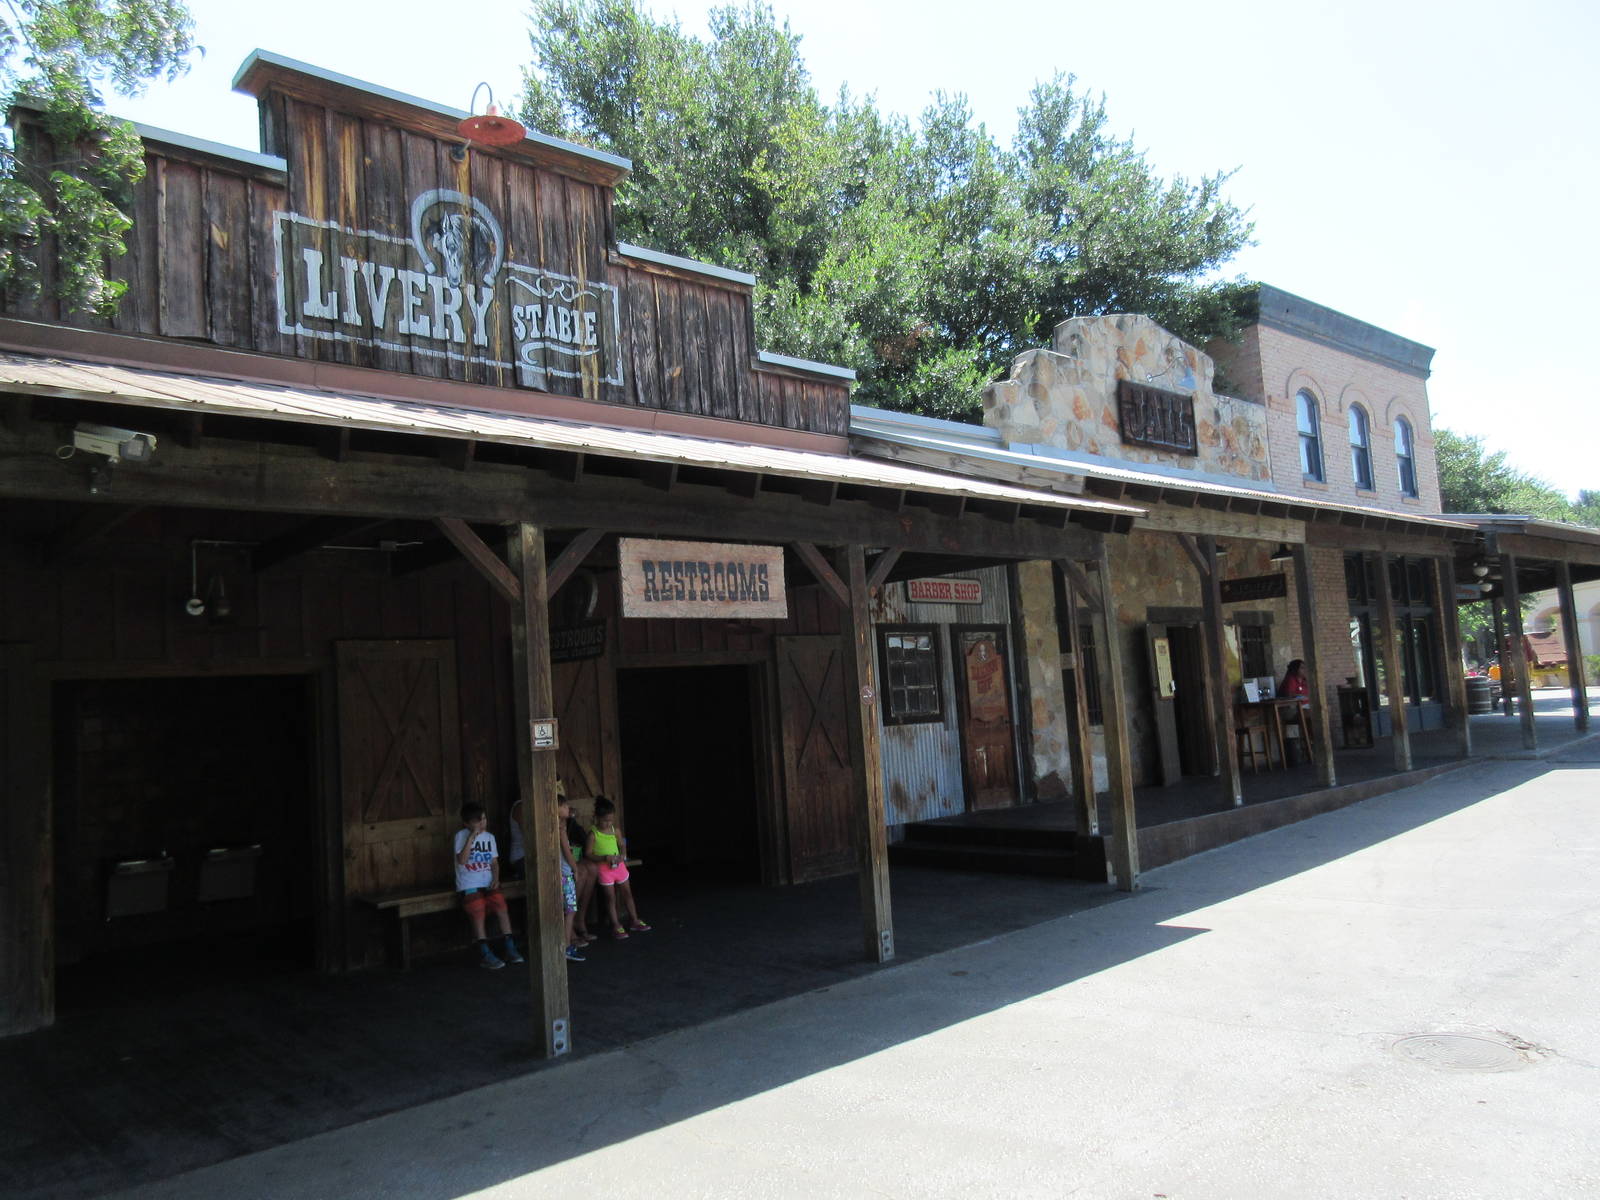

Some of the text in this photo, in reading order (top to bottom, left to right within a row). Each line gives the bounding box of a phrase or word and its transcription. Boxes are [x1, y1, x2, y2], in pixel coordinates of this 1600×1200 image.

[303, 248, 494, 348] LIVERY
[1123, 388, 1193, 450] JAIL
[642, 559, 770, 602] RESTROOMS
[910, 581, 980, 601] BARBER SHOP
[551, 625, 603, 649] STROOMS
